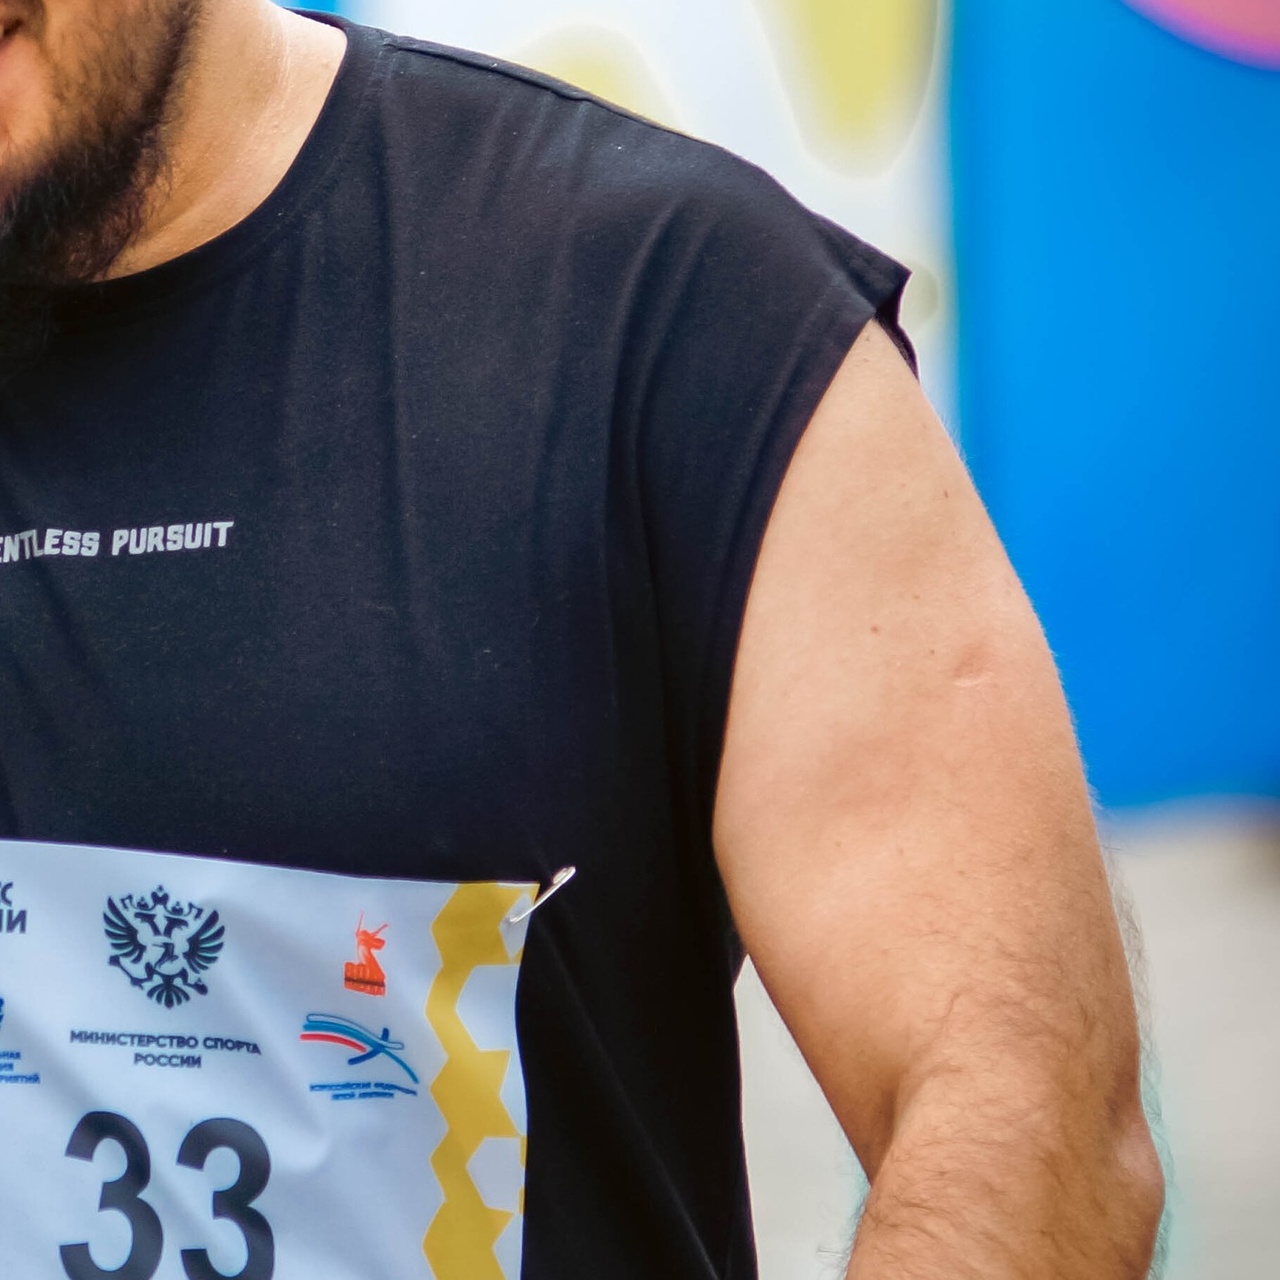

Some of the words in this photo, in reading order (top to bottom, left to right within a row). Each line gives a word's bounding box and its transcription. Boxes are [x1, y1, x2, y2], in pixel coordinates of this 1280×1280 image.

[111, 521, 235, 556] PURSUIT
[70, 1030, 199, 1049] МИНИСТЕРСТВО
[202, 1037, 262, 1055] СПОРТА
[133, 1053, 202, 1068] РОССИИ
